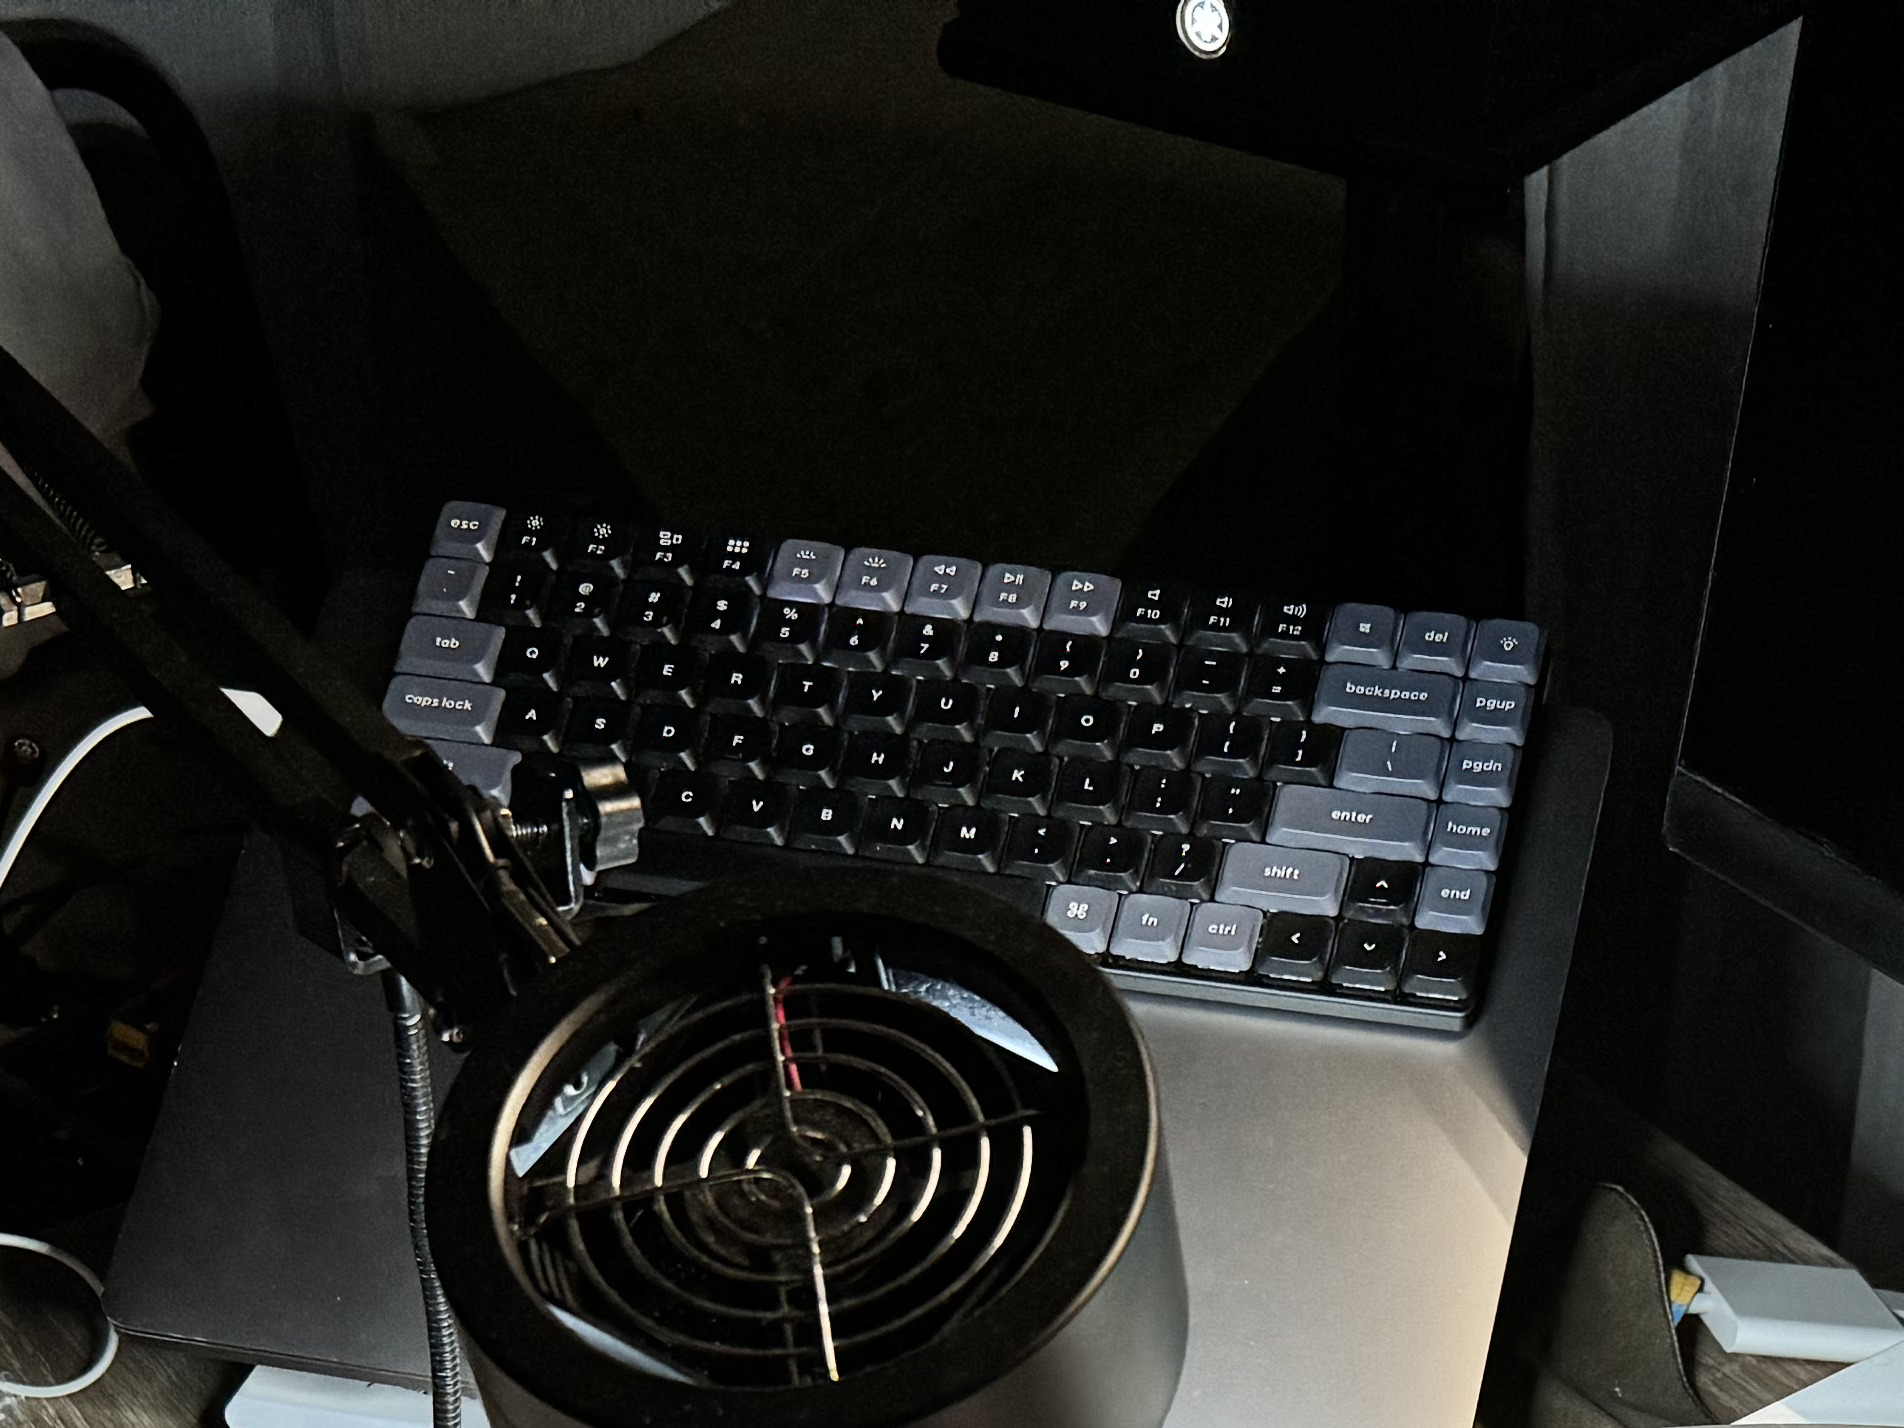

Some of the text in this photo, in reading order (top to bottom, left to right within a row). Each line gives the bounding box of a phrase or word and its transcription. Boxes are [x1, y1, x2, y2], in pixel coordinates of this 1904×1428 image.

[450, 518, 480, 530] esc
[521, 535, 537, 546] F1
[587, 543, 605, 555] F2
[654, 551, 673, 563] F3
[722, 559, 741, 570] F4
[791, 567, 809, 579] F5
[929, 583, 948, 594] F7
[575, 602, 585, 612] 2
[1069, 599, 1087, 611] F9
[643, 611, 653, 621] 3
[1136, 607, 1161, 620] F10
[711, 619, 721, 629] 4
[1208, 615, 1230, 627] F11
[780, 627, 790, 637] 5
[1277, 623, 1302, 636] F12
[850, 635, 858, 645] 6
[1424, 630, 1449, 643] del
[435, 636, 460, 649] tab
[920, 643, 929, 653] 7
[526, 648, 538, 658] Q
[594, 656, 609, 667] W
[1060, 660, 1069, 670] 9
[663, 665, 674, 676] E
[731, 673, 743, 684] R
[803, 681, 813, 692] T
[1345, 681, 1429, 701] backspace
[872, 690, 882, 701] Y
[405, 694, 473, 711] caps lock
[941, 698, 953, 709] U
[1475, 697, 1516, 712] pgup
[525, 709, 536, 720] A
[595, 718, 606, 729] S
[1152, 724, 1163, 734] P
[663, 726, 675, 737] D
[733, 736, 744, 746] F
[802, 744, 814, 755] G
[871, 752, 884, 764] H
[944, 761, 953, 772] J
[1461, 759, 1502, 773] pgdn
[1012, 770, 1024, 782] K
[1084, 778, 1093, 790] L
[682, 791, 693, 802] C
[752, 800, 763, 811] V
[821, 809, 832, 820] B
[1331, 810, 1373, 824] enter
[891, 818, 903, 830] N
[1446, 820, 1491, 837] home
[961, 827, 976, 838] M
[1263, 865, 1300, 880] shift
[1440, 888, 1471, 900] end
[1141, 912, 1158, 927] fn
[1207, 923, 1237, 936] ctrl
